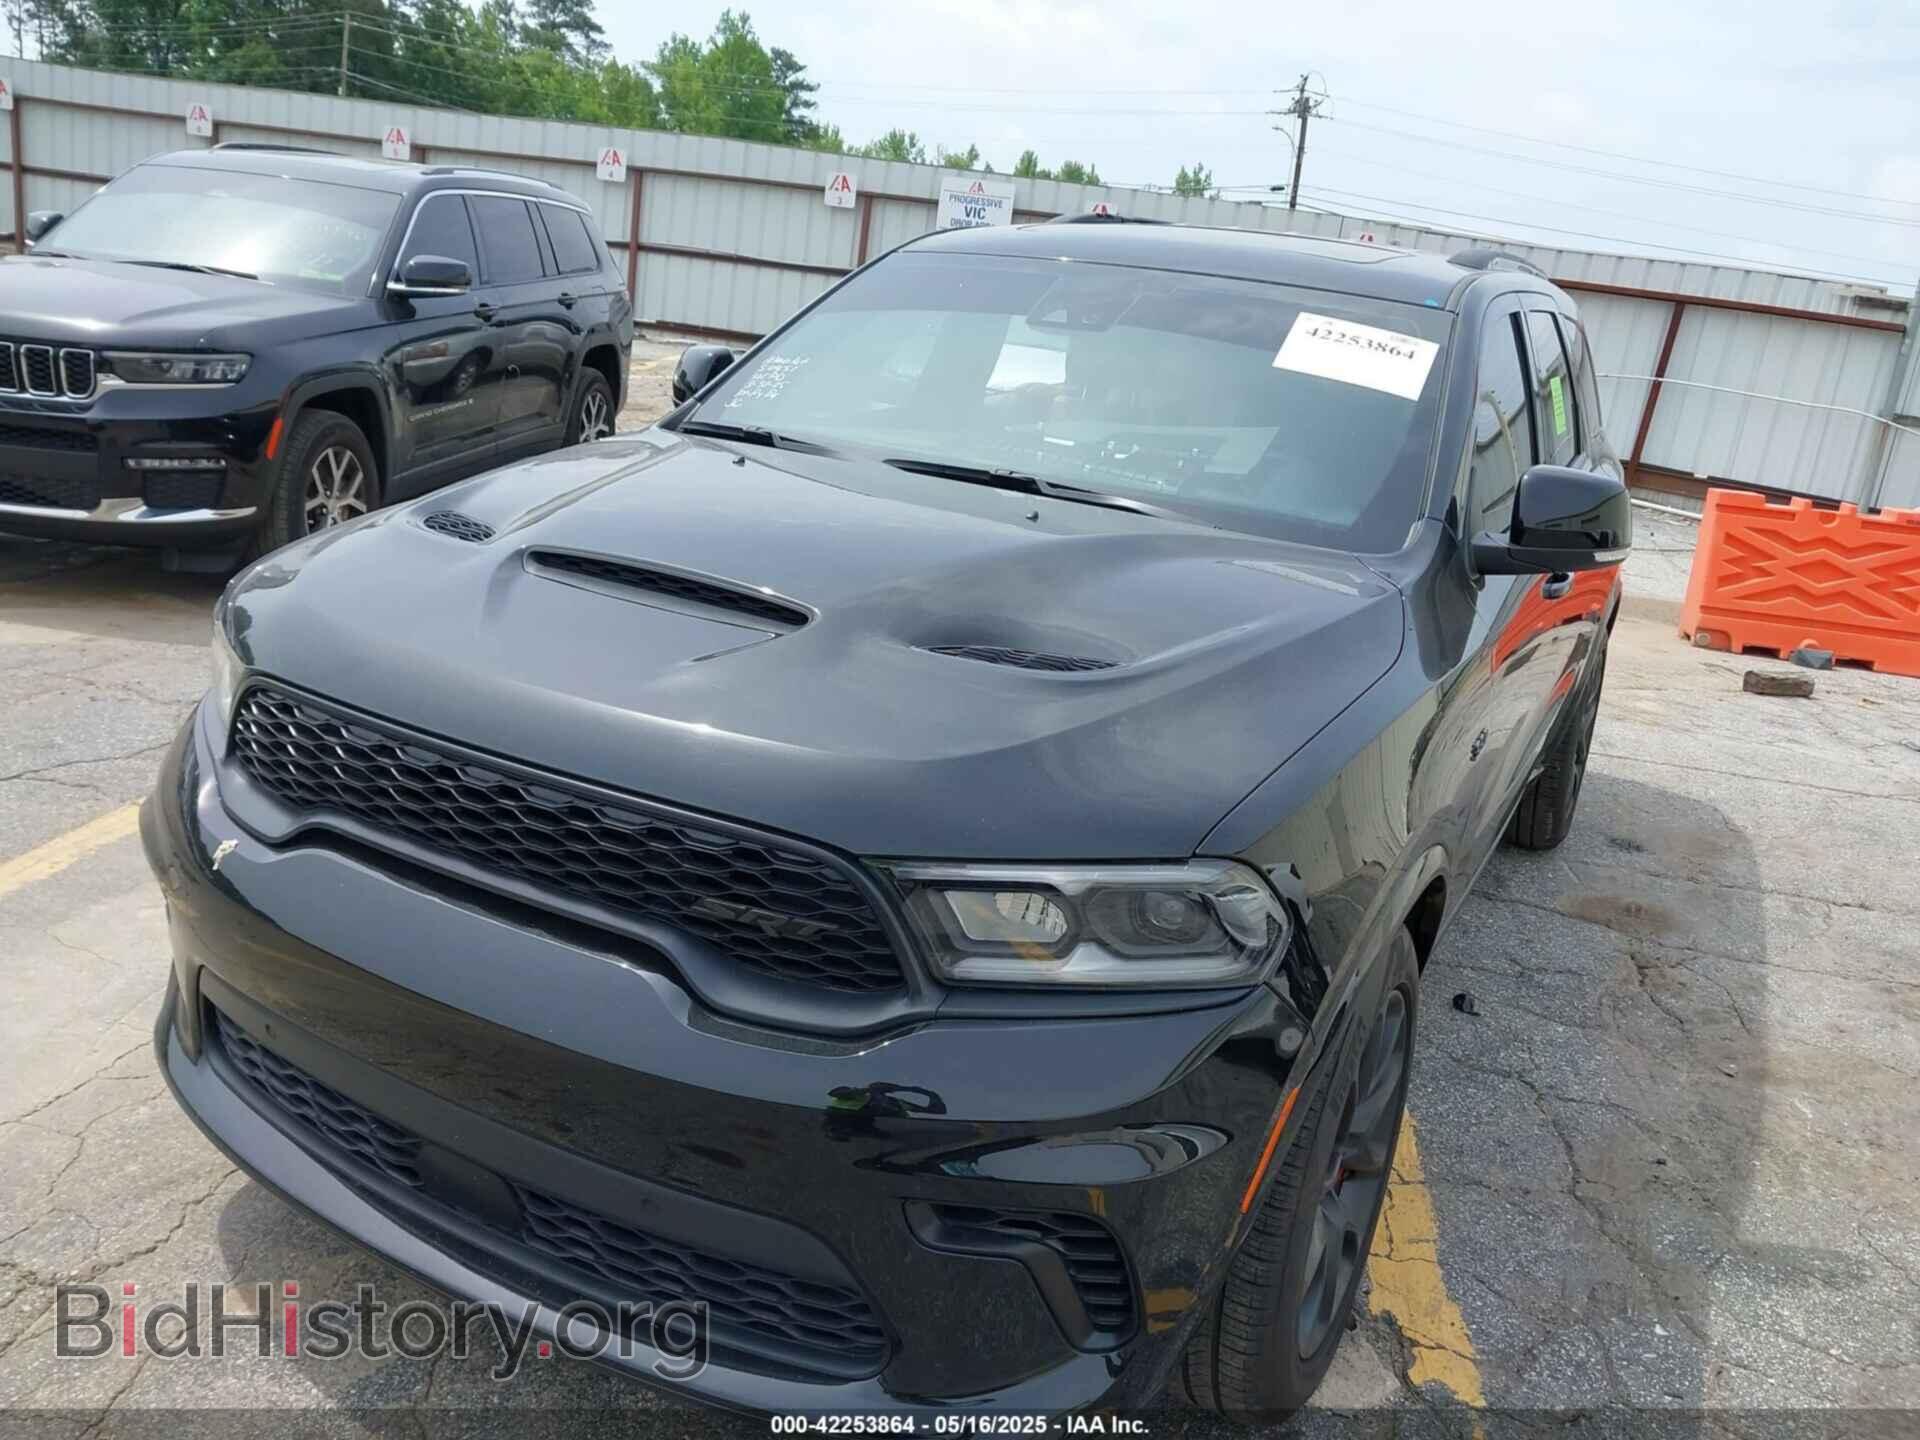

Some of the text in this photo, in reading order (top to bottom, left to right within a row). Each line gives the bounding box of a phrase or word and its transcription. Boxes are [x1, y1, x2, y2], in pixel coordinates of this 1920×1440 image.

[949, 193, 1003, 208] PROGRESSIVE
[964, 206, 986, 220] VIC
[1305, 327, 1416, 360] 42253864
[690, 898, 839, 940] SRT
